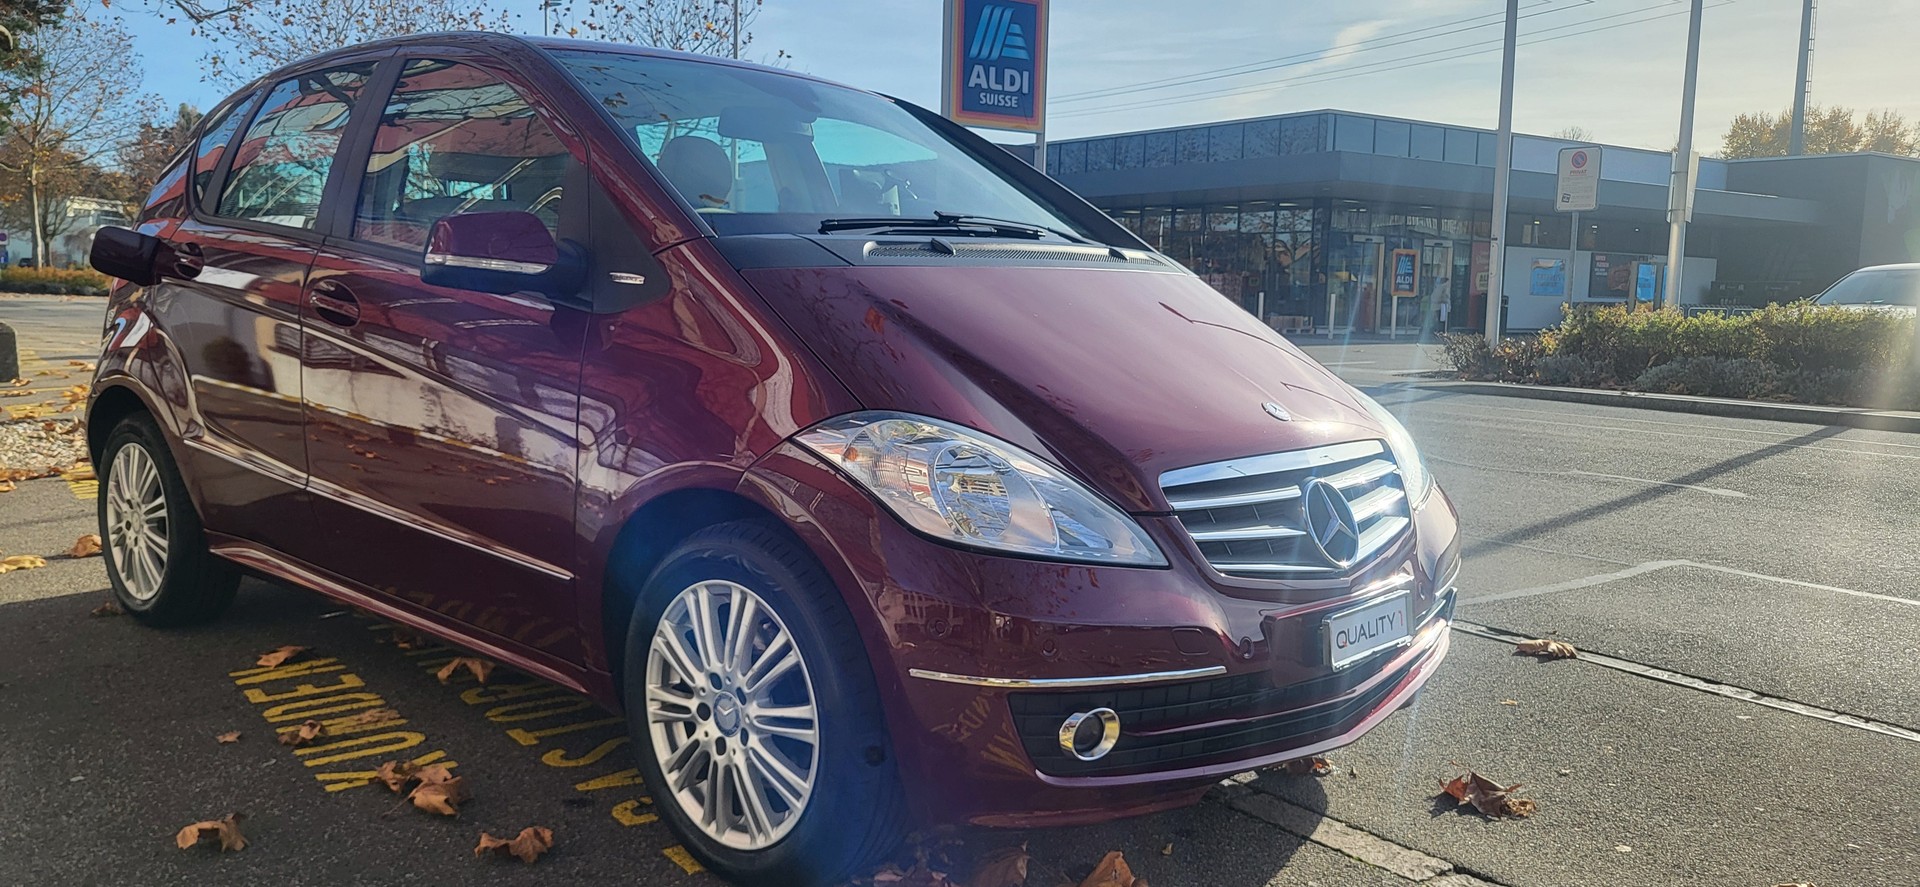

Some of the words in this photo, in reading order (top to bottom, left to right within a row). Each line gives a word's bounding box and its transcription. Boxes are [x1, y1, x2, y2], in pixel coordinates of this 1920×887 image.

[968, 64, 1030, 94] ALDI
[979, 92, 1019, 108] SUISSE
[1396, 275, 1413, 284] ALDI
[1336, 611, 1396, 650] QUALITY
